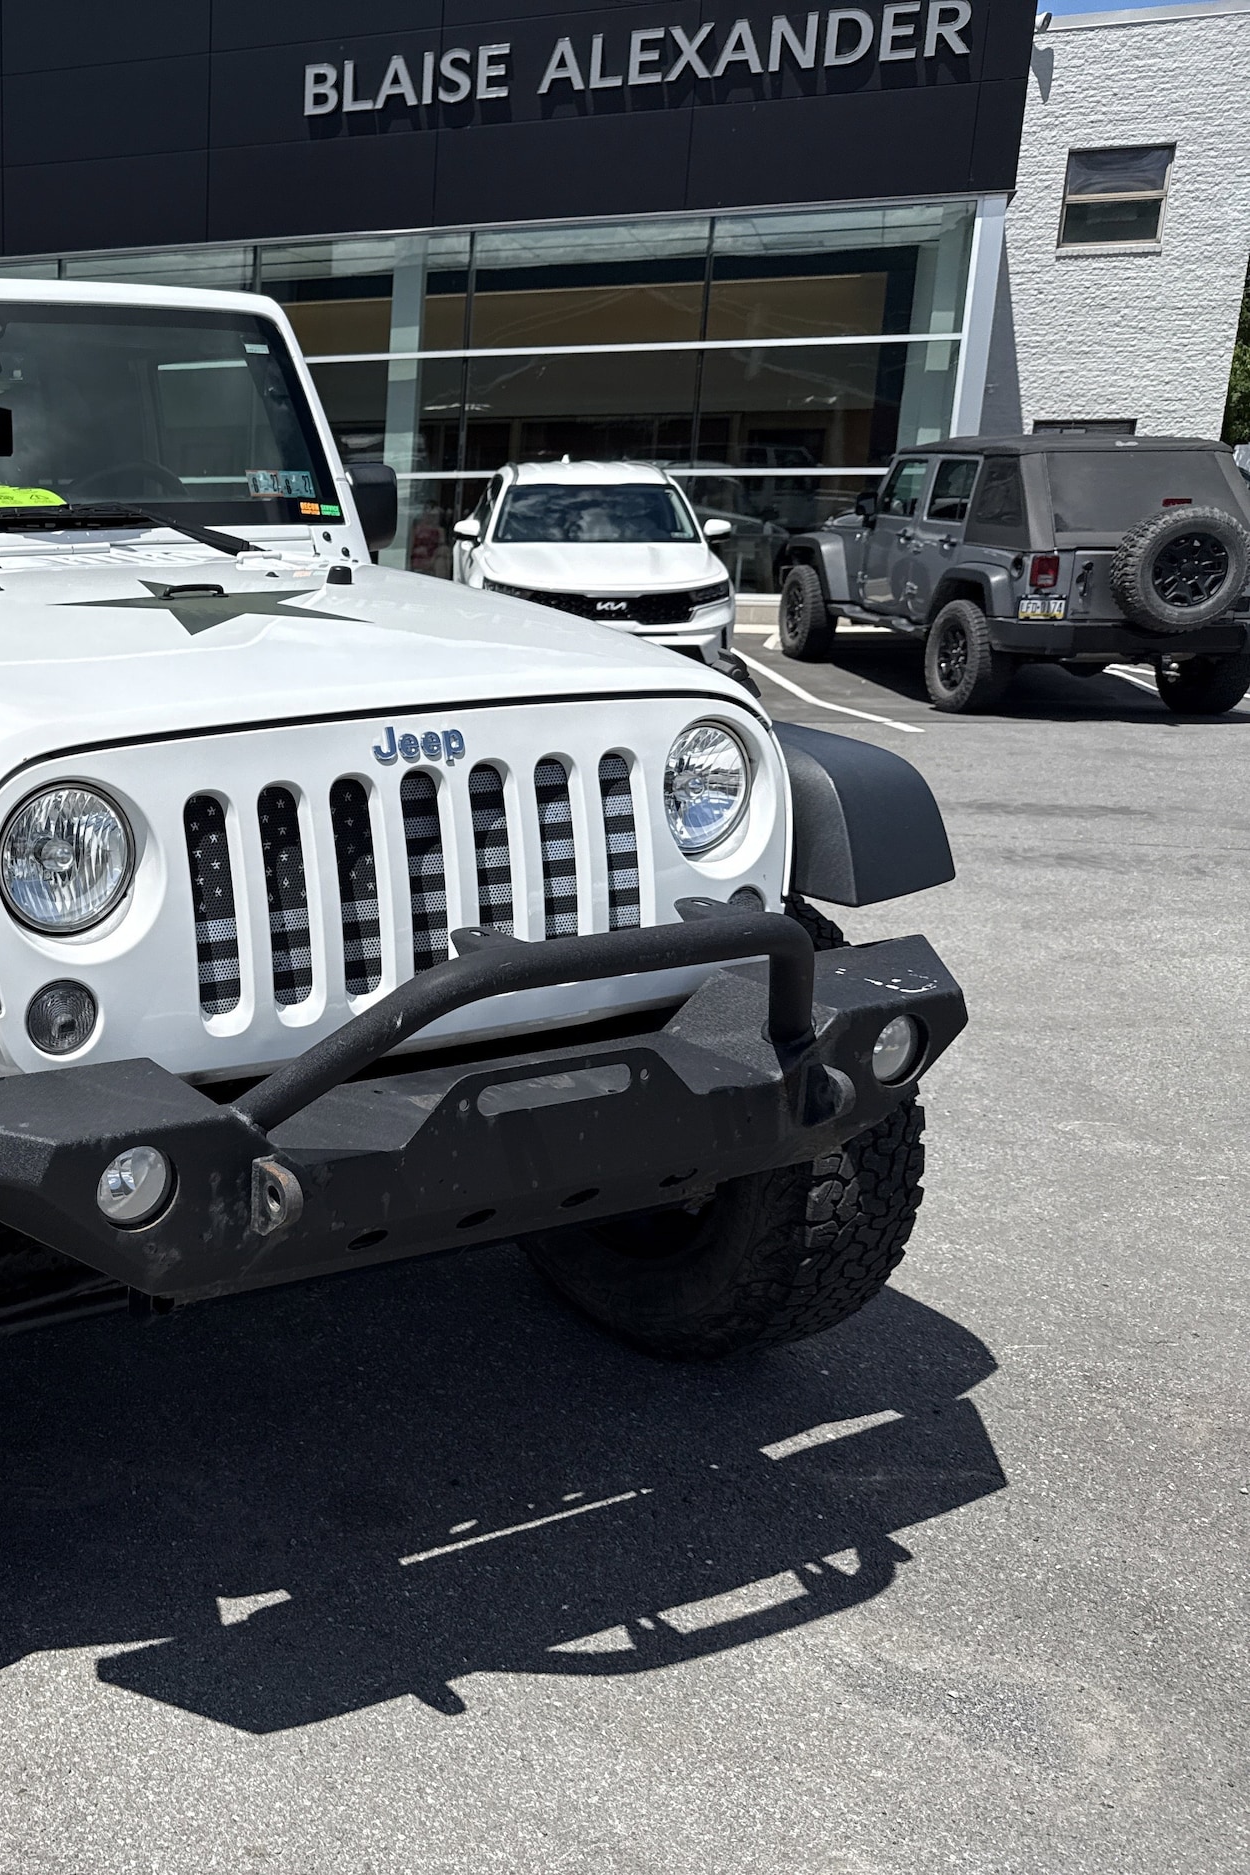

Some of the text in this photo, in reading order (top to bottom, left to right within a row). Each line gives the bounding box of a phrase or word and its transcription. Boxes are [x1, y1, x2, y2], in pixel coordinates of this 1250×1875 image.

[303, 0, 973, 116] BLAISE ALEXANDER
[372, 726, 465, 763] Jeep
